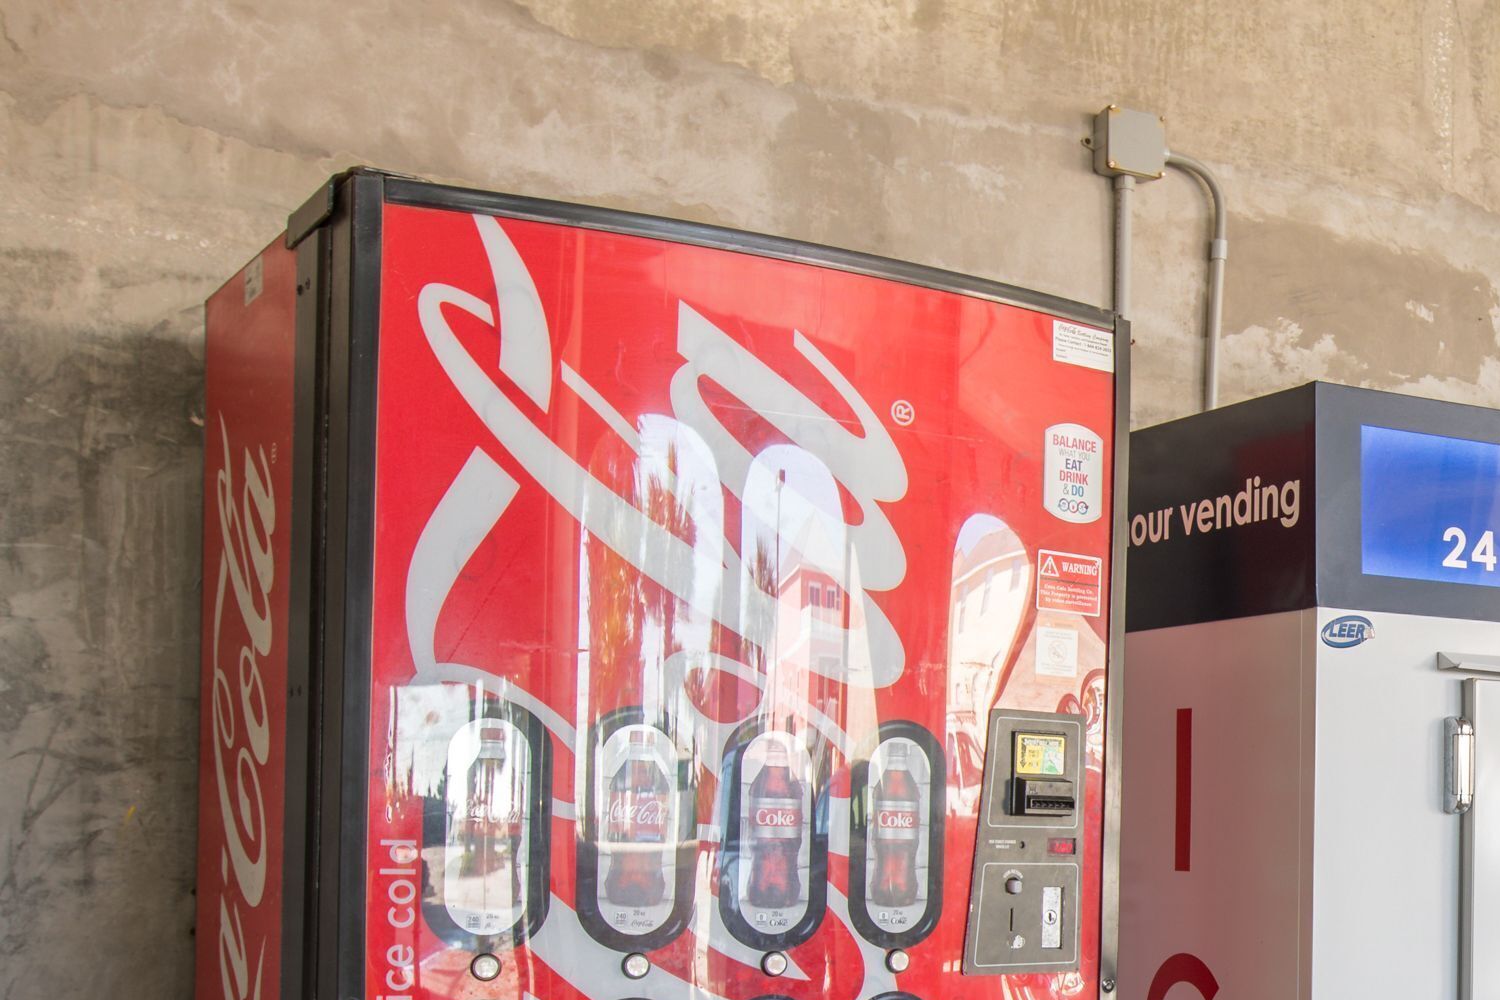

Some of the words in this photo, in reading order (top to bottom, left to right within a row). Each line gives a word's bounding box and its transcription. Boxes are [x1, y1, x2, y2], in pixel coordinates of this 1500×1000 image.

[1052, 434, 1097, 453] BALANCE
[1059, 448, 1076, 457] WHAT
[1078, 452, 1091, 461] YOU
[1065, 458, 1083, 471] EAT
[1060, 470, 1088, 485] DRINK
[1071, 485, 1084, 497] DO
[1127, 506, 1173, 547] our
[1180, 476, 1300, 528] vending
[1442, 527, 1497, 572] 24
[1061, 561, 1097, 576] WARNING
[1329, 623, 1366, 641] LEER
[756, 809, 794, 826] Coke
[880, 811, 913, 827] Coke
[379, 839, 418, 928] cold
